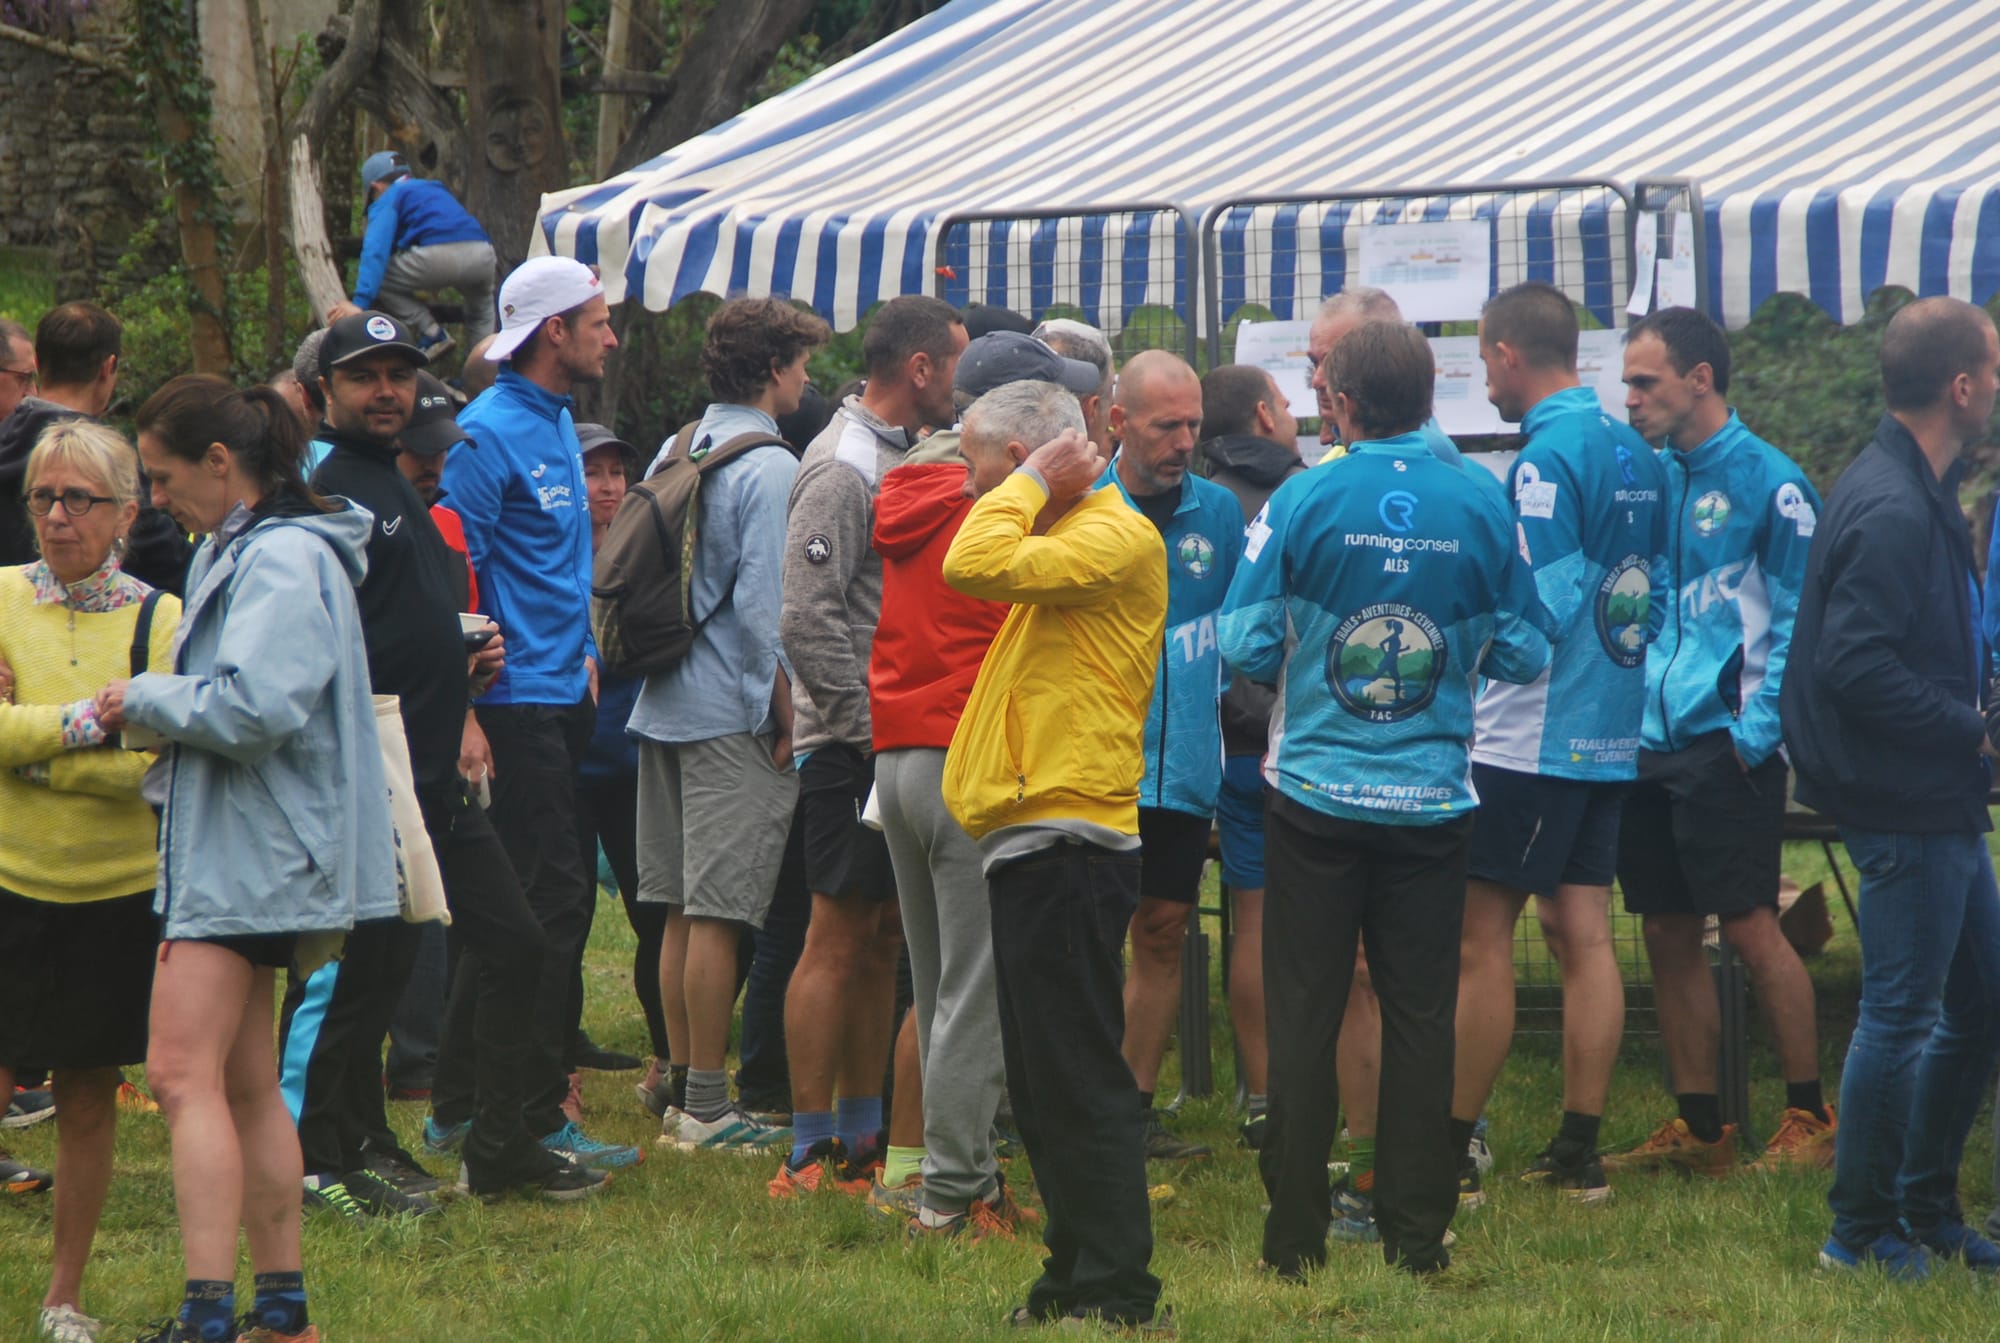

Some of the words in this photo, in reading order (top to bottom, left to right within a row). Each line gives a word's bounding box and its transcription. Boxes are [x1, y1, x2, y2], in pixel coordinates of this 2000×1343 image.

[1345, 533, 1459, 553] runningconseil
[1681, 561, 1744, 618] TAC
[1173, 615, 1217, 663] TA
[1335, 615, 1360, 642] TRAILS
[1361, 603, 1413, 621] AVENTURES
[1359, 784, 1453, 799] AVENTURES
